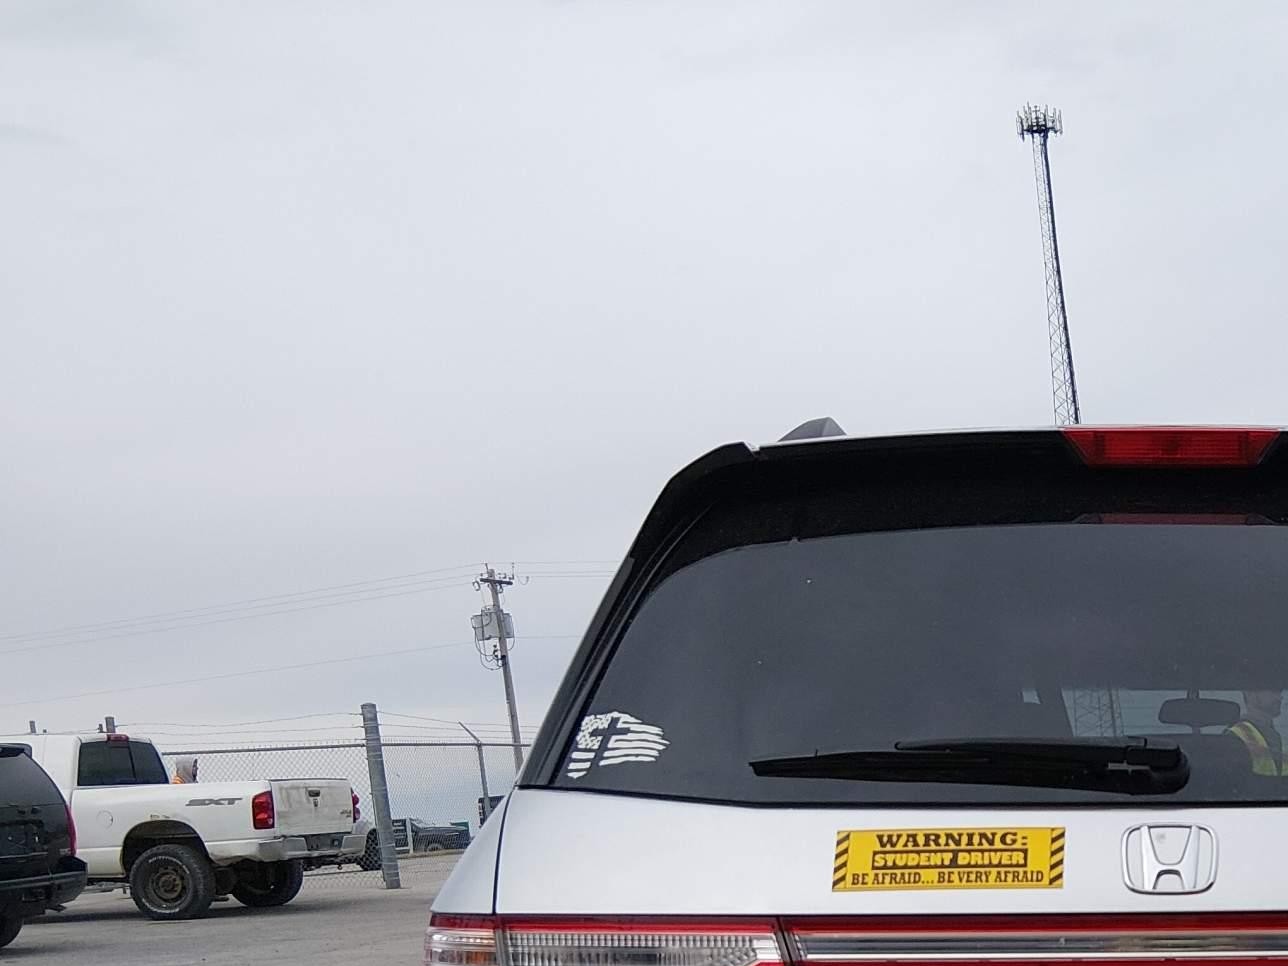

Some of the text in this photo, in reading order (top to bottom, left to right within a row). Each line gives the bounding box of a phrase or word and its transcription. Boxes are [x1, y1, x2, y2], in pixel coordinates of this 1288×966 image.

[876, 831, 1029, 849] WARNING:
[873, 850, 1025, 868] STUDENT DRIVER
[851, 872, 869, 886] BE
[937, 870, 955, 885] BE
[956, 870, 992, 885] VERY
[994, 869, 1044, 885] AFRAID
